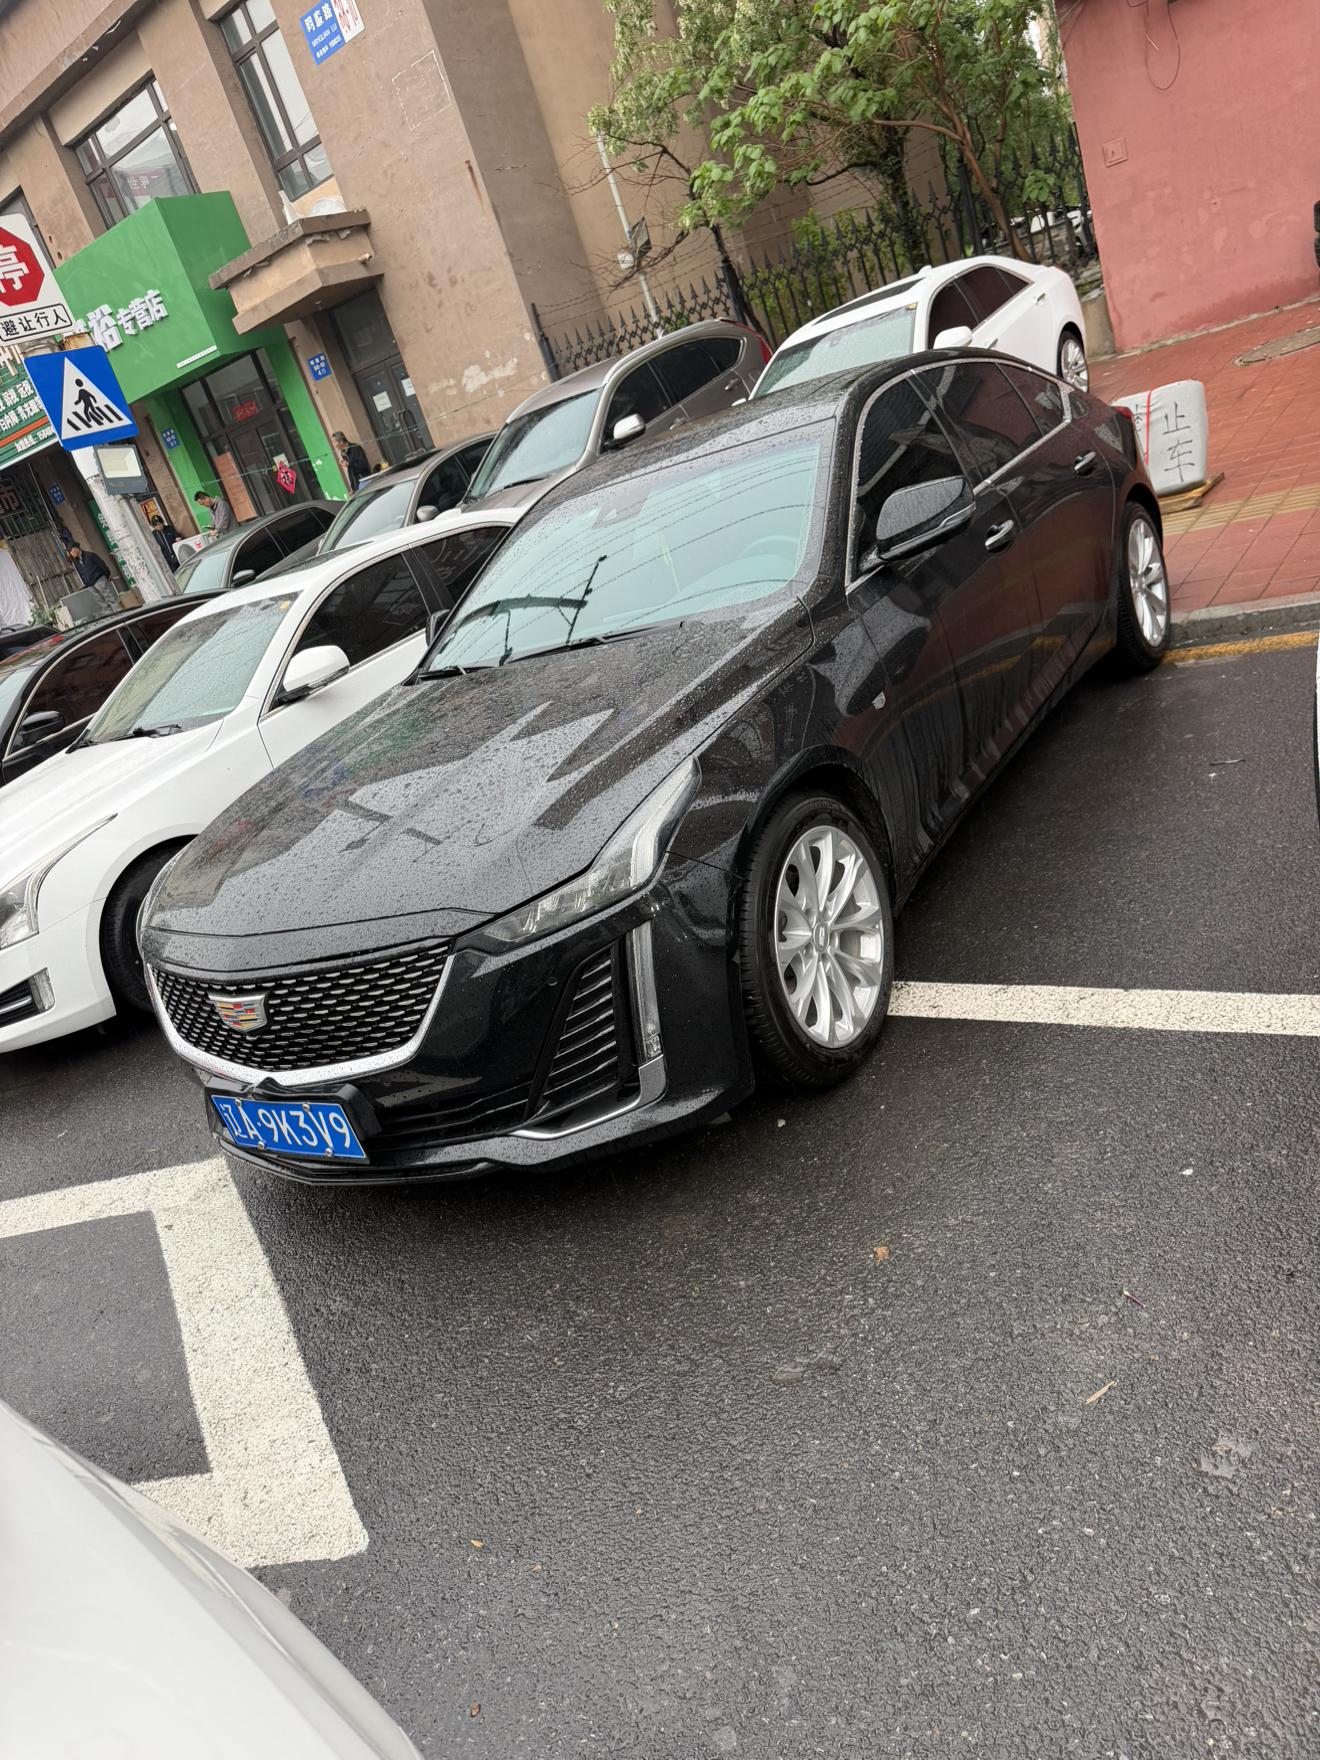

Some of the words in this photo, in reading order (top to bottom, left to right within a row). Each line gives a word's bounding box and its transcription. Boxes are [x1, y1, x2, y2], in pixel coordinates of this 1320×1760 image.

[0, 309, 67, 337] 避让行人
[74, 289, 168, 352] 裕专营店
